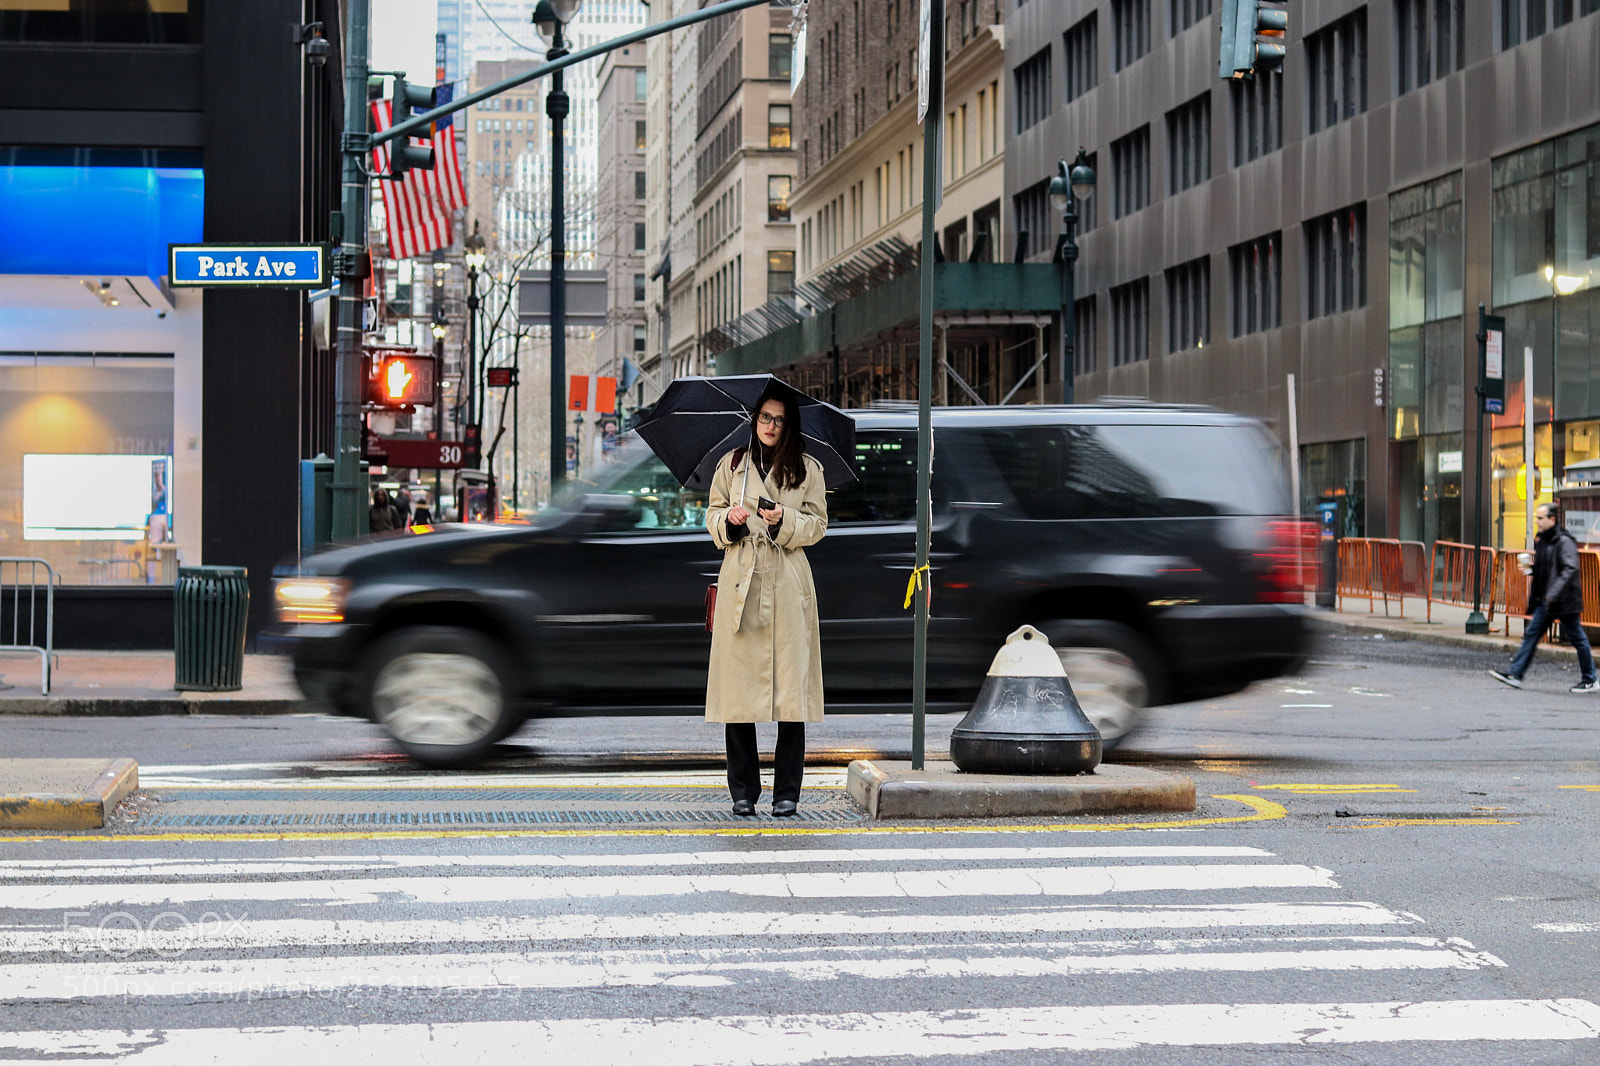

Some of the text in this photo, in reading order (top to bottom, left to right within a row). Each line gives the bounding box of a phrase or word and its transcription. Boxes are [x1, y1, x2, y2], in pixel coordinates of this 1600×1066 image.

[198, 256, 297, 277] Park Ave
[439, 445, 462, 464] 30
[1325, 511, 1333, 523] P
